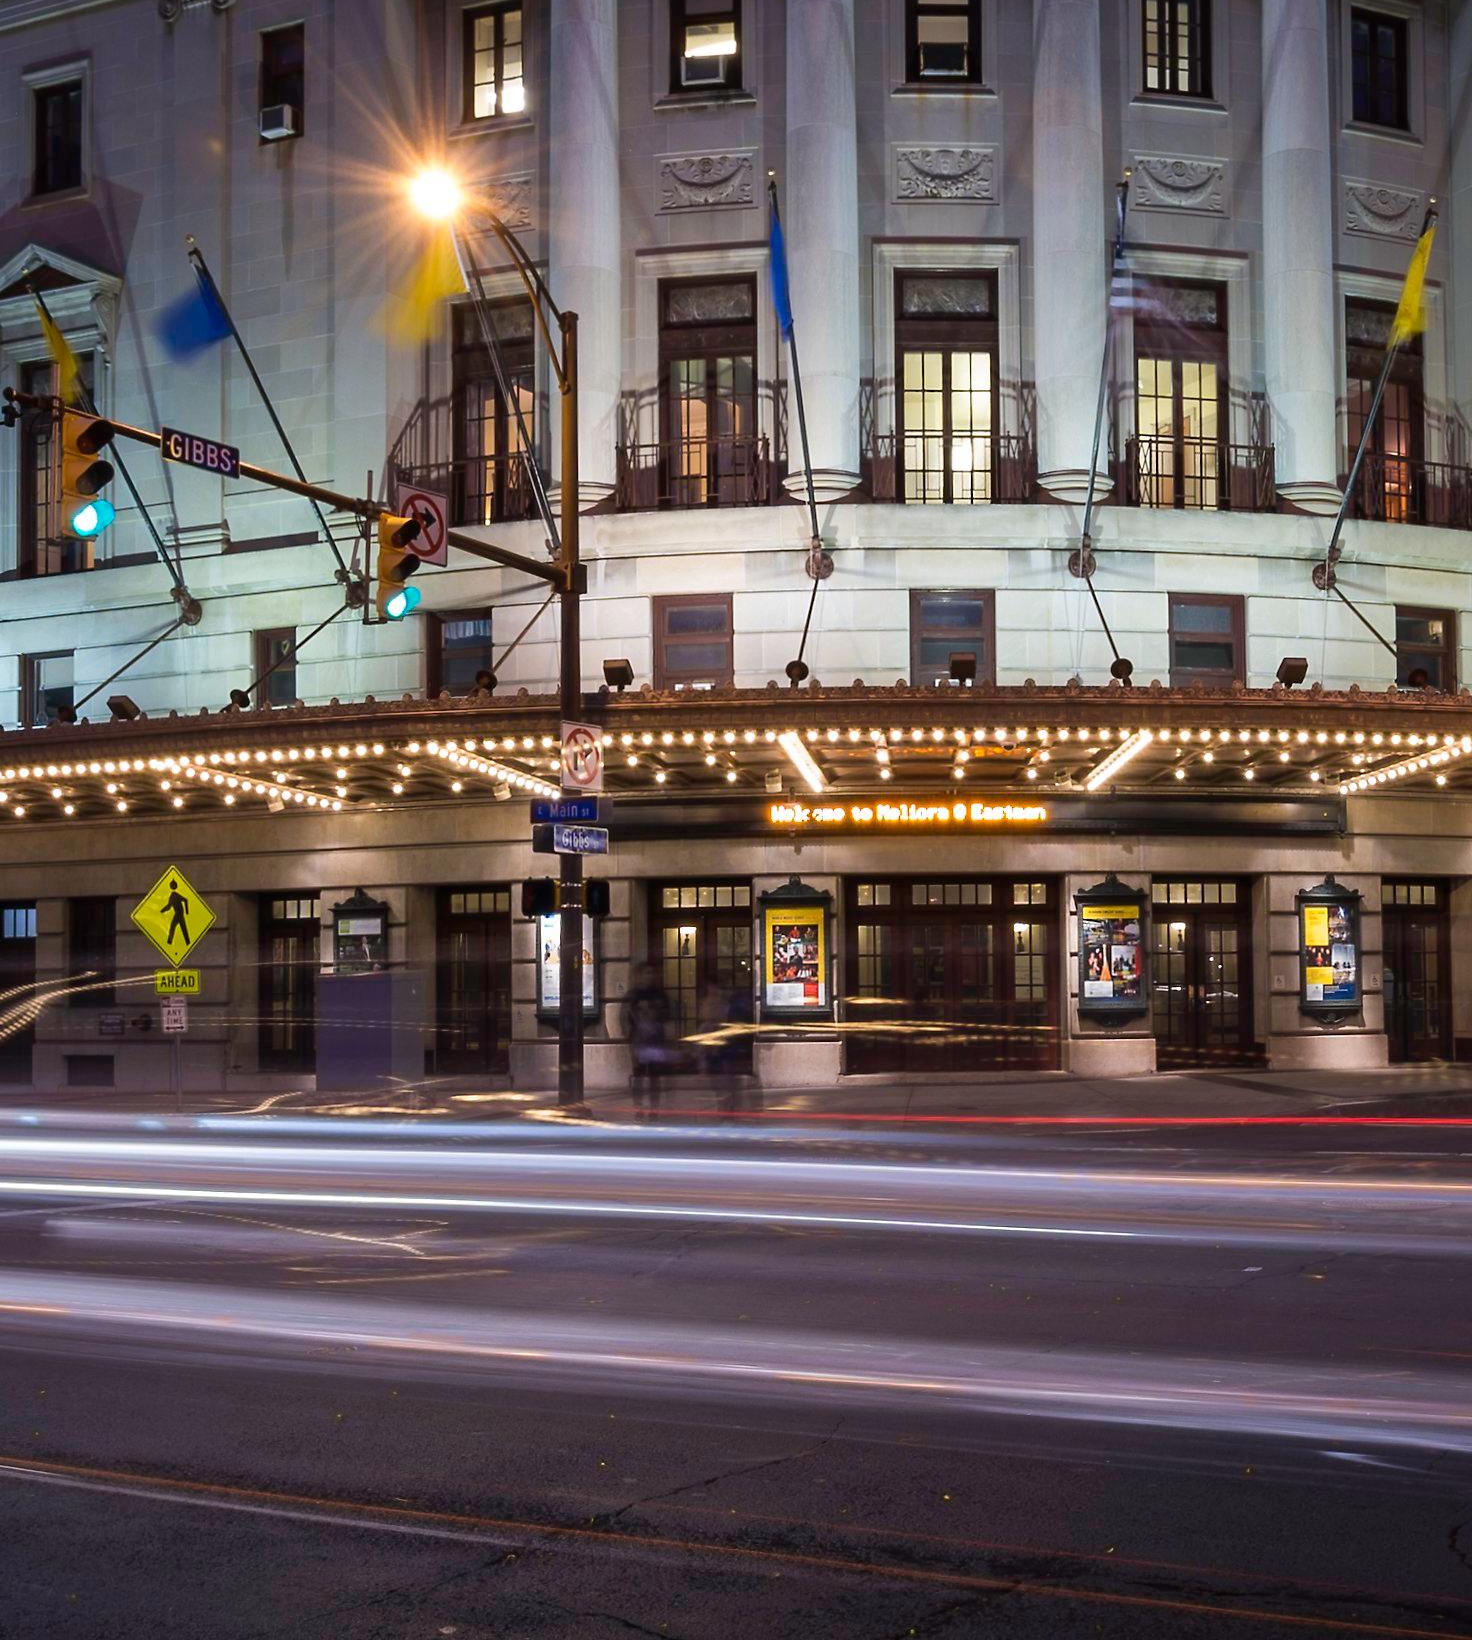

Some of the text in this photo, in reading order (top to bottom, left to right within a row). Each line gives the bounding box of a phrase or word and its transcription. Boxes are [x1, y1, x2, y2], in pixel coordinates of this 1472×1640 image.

[170, 433, 231, 471] GIBBS
[550, 802, 578, 818] Main
[771, 804, 846, 823] Welcome
[851, 806, 874, 821] to
[970, 803, 1047, 821] Eastman
[561, 829, 590, 849] Gibbs
[160, 976, 195, 988] AHEAD
